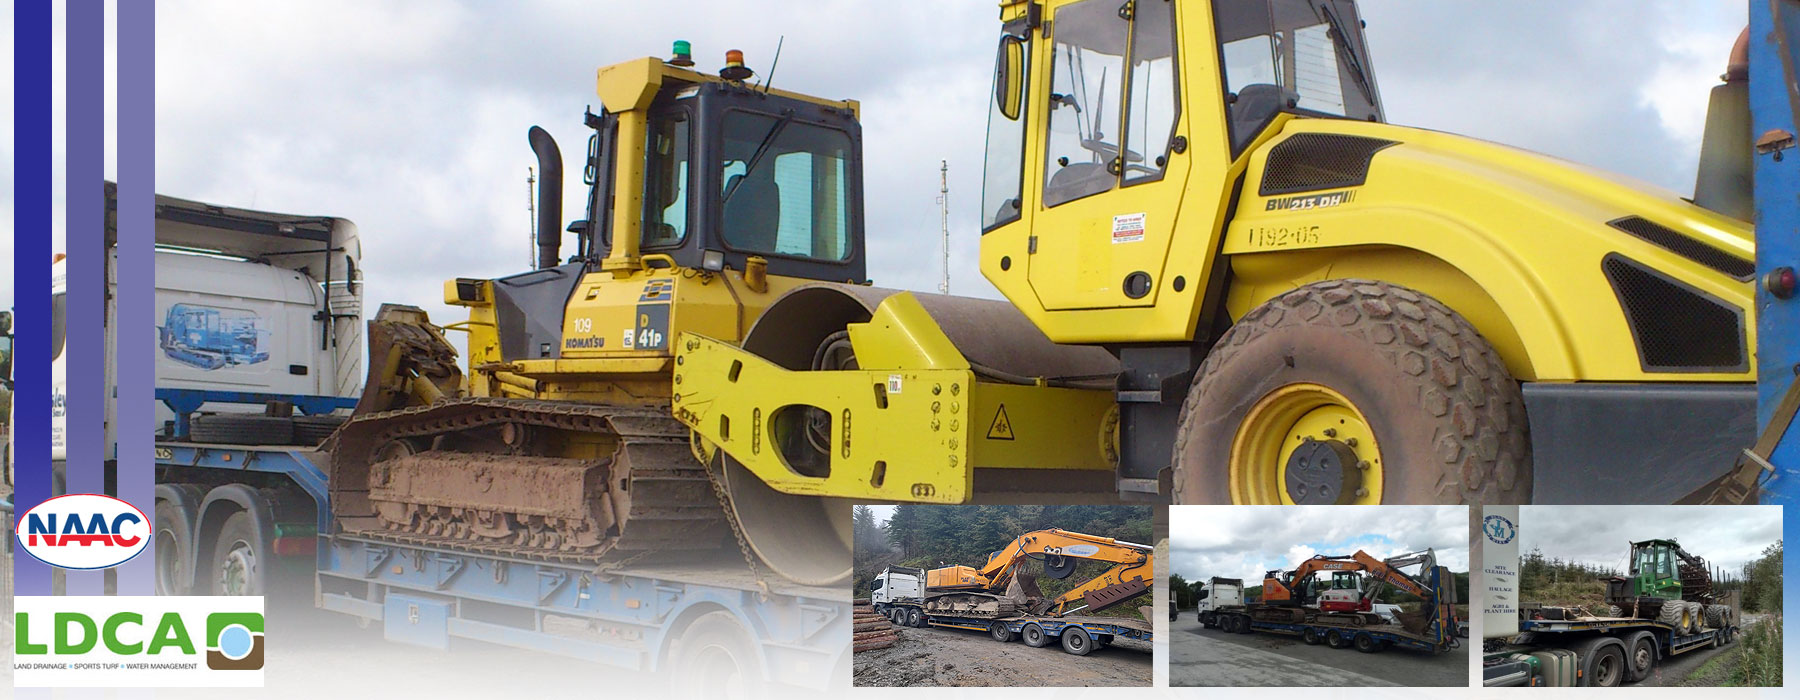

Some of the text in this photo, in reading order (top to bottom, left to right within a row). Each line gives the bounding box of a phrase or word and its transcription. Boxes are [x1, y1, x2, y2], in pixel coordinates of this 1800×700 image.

[1319, 195, 1342, 208] DH
[574, 318, 592, 333] 109
[641, 314, 649, 327] D
[566, 336, 605, 348] KOMATSU
